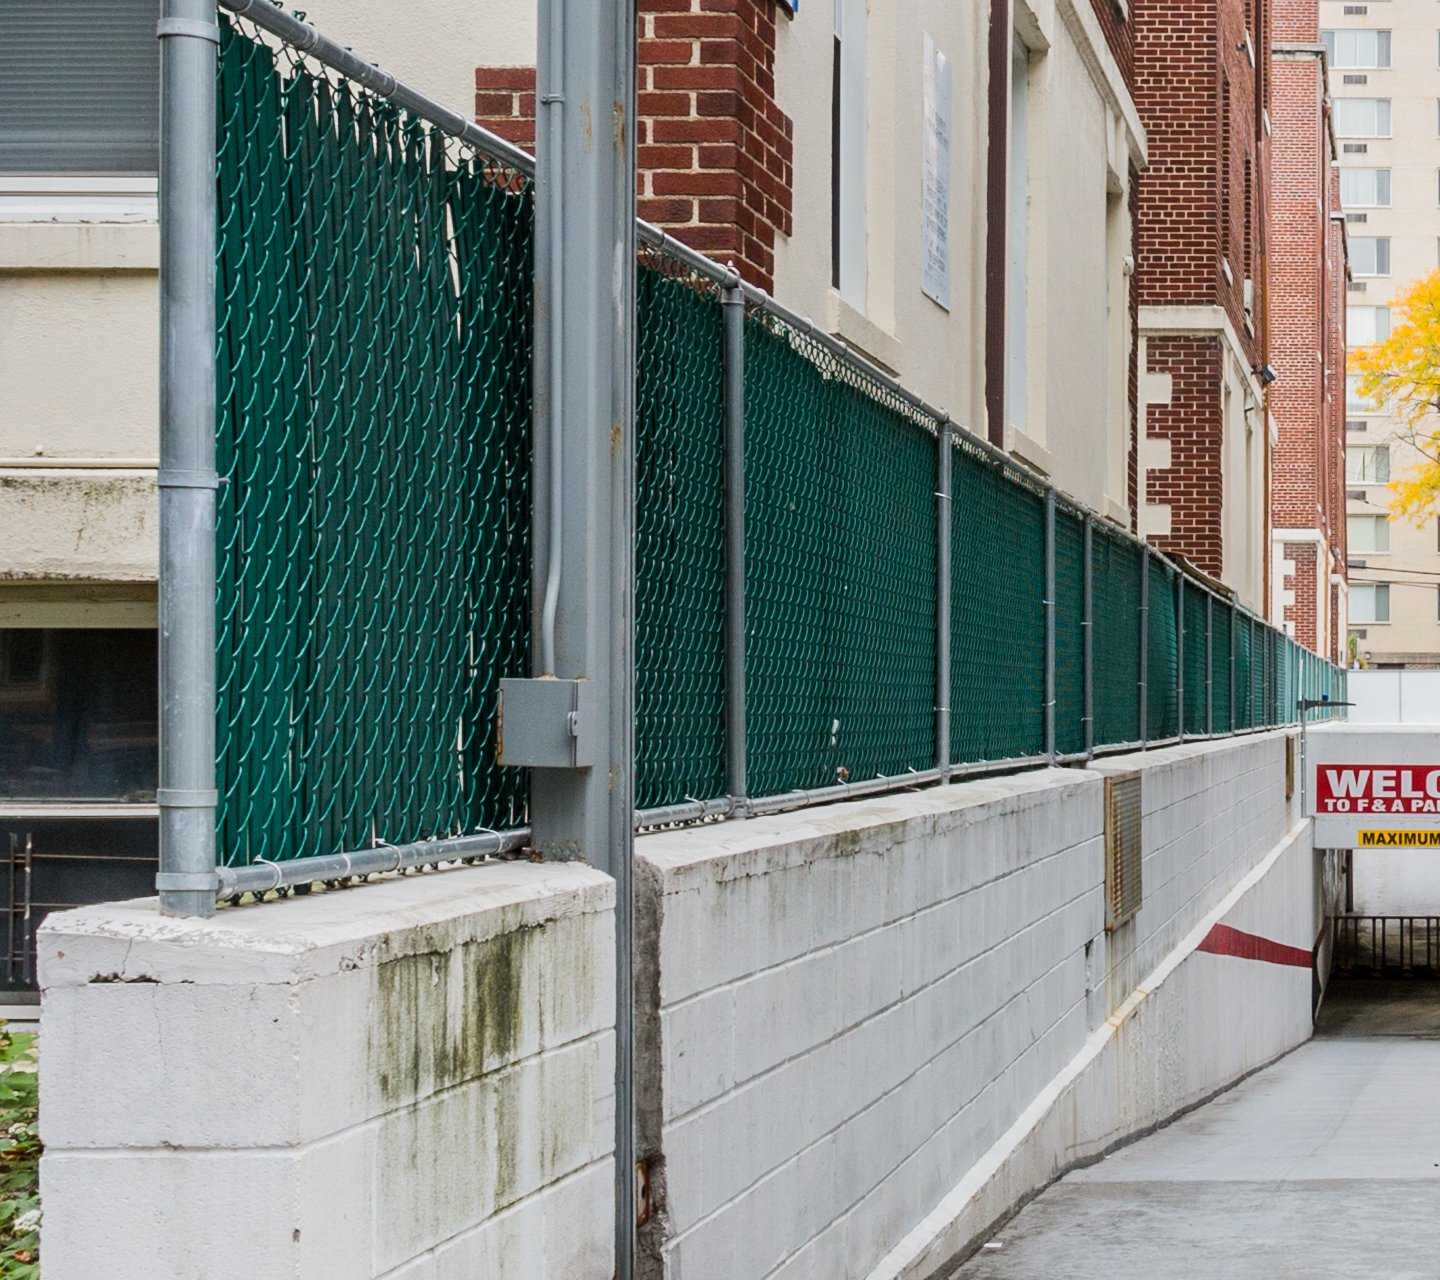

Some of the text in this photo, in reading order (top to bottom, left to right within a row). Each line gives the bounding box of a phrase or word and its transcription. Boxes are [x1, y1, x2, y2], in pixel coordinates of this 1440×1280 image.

[1324, 798, 1350, 812] TO
[1357, 798, 1369, 812] F
[1371, 798, 1387, 813] &
[1391, 798, 1405, 812] A
